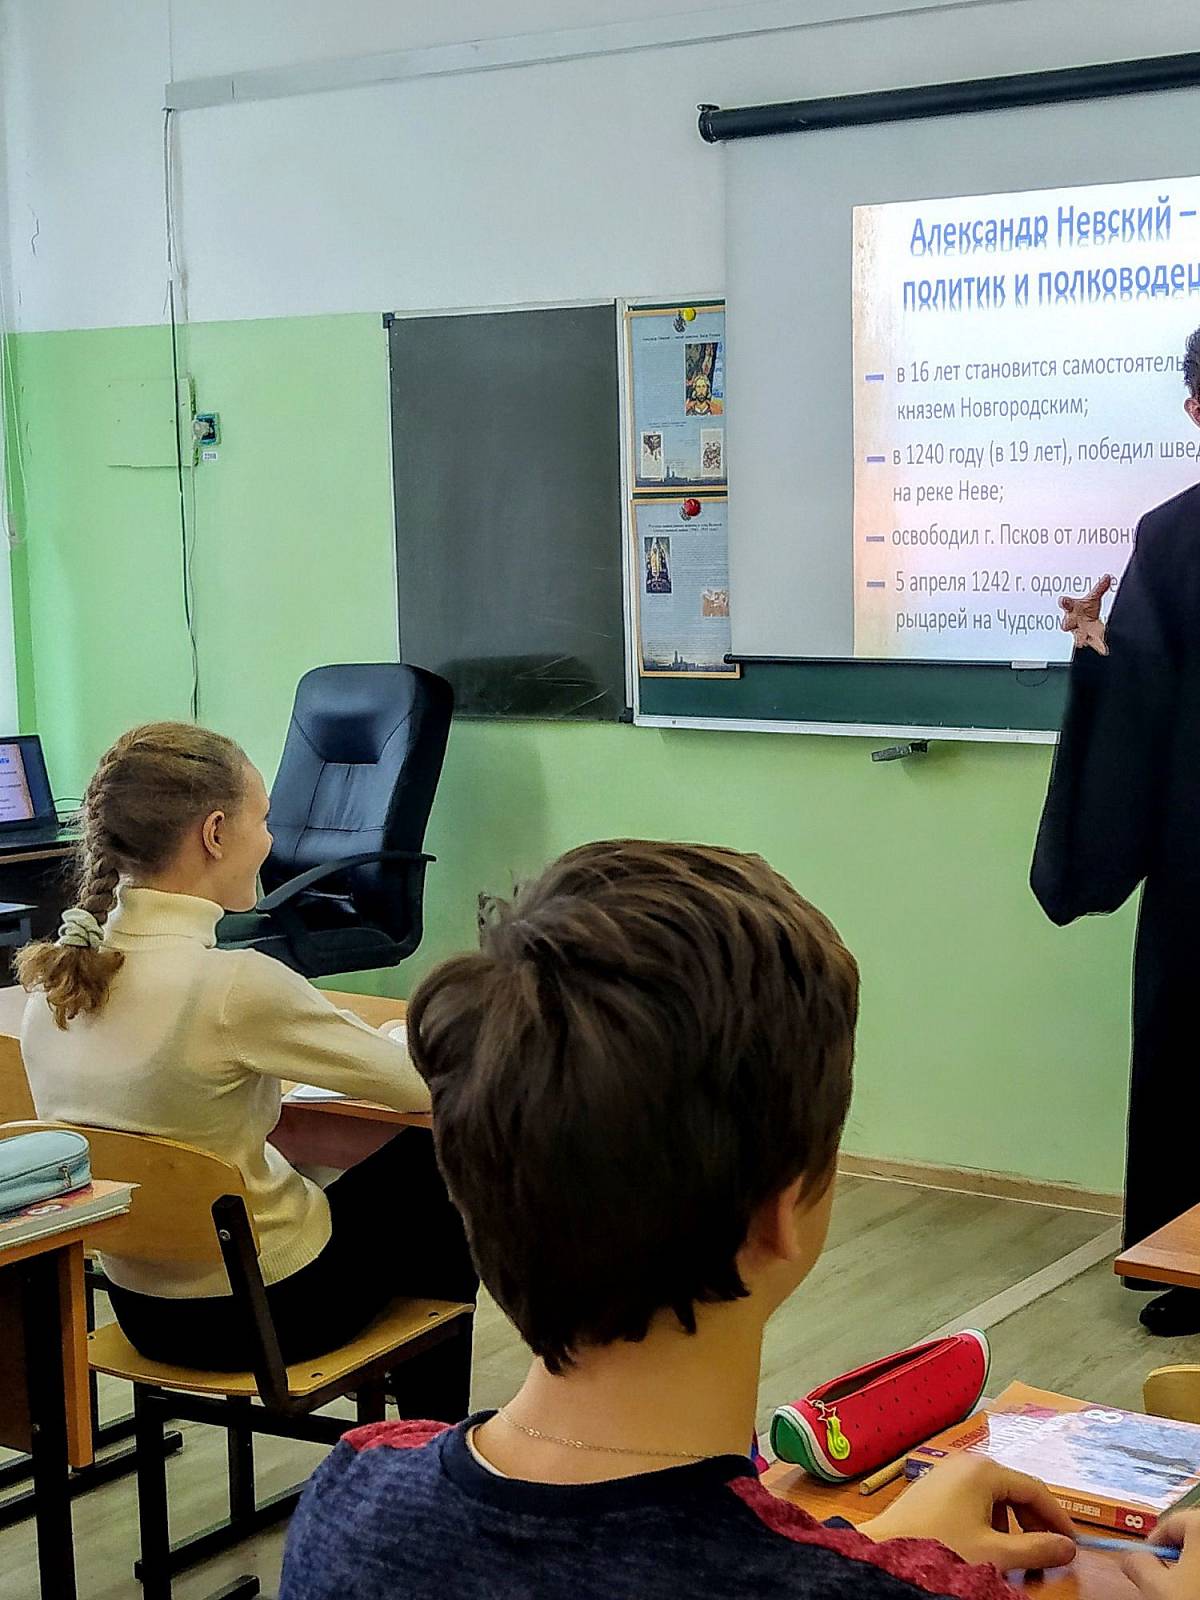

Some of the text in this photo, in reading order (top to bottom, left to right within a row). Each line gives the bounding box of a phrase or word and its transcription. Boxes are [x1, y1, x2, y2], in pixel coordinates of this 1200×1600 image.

[911, 214, 1048, 247] Александр
[1057, 196, 1171, 241] Невский
[903, 275, 1006, 305] политик
[1015, 274, 1029, 299] и
[897, 366, 906, 382] в
[911, 361, 929, 382] 16
[934, 363, 961, 382] лет
[965, 357, 1057, 380] становится
[898, 394, 1089, 422] князем Новгородским;
[892, 450, 901, 466] в
[906, 443, 944, 466] 1240
[949, 448, 984, 469] году
[990, 440, 1004, 468] (в
[1010, 441, 1029, 462] 19
[1033, 438, 1073, 466] лет),
[1078, 436, 1154, 462] победил
[893, 480, 1004, 507] на реке Неве;
[892, 524, 979, 549] освободил
[984, 529, 995, 545] г.
[1000, 524, 1049, 545] Псков
[1055, 529, 1073, 545] от
[895, 571, 905, 592] 5
[909, 575, 967, 599] апреля
[972, 571, 1011, 592] 1242
[1015, 576, 1027, 592] г.
[1030, 576, 1092, 597] одолел
[896, 607, 966, 635] рыцарей
[973, 614, 992, 630] на
[1124, 1513, 1144, 1530] 8
